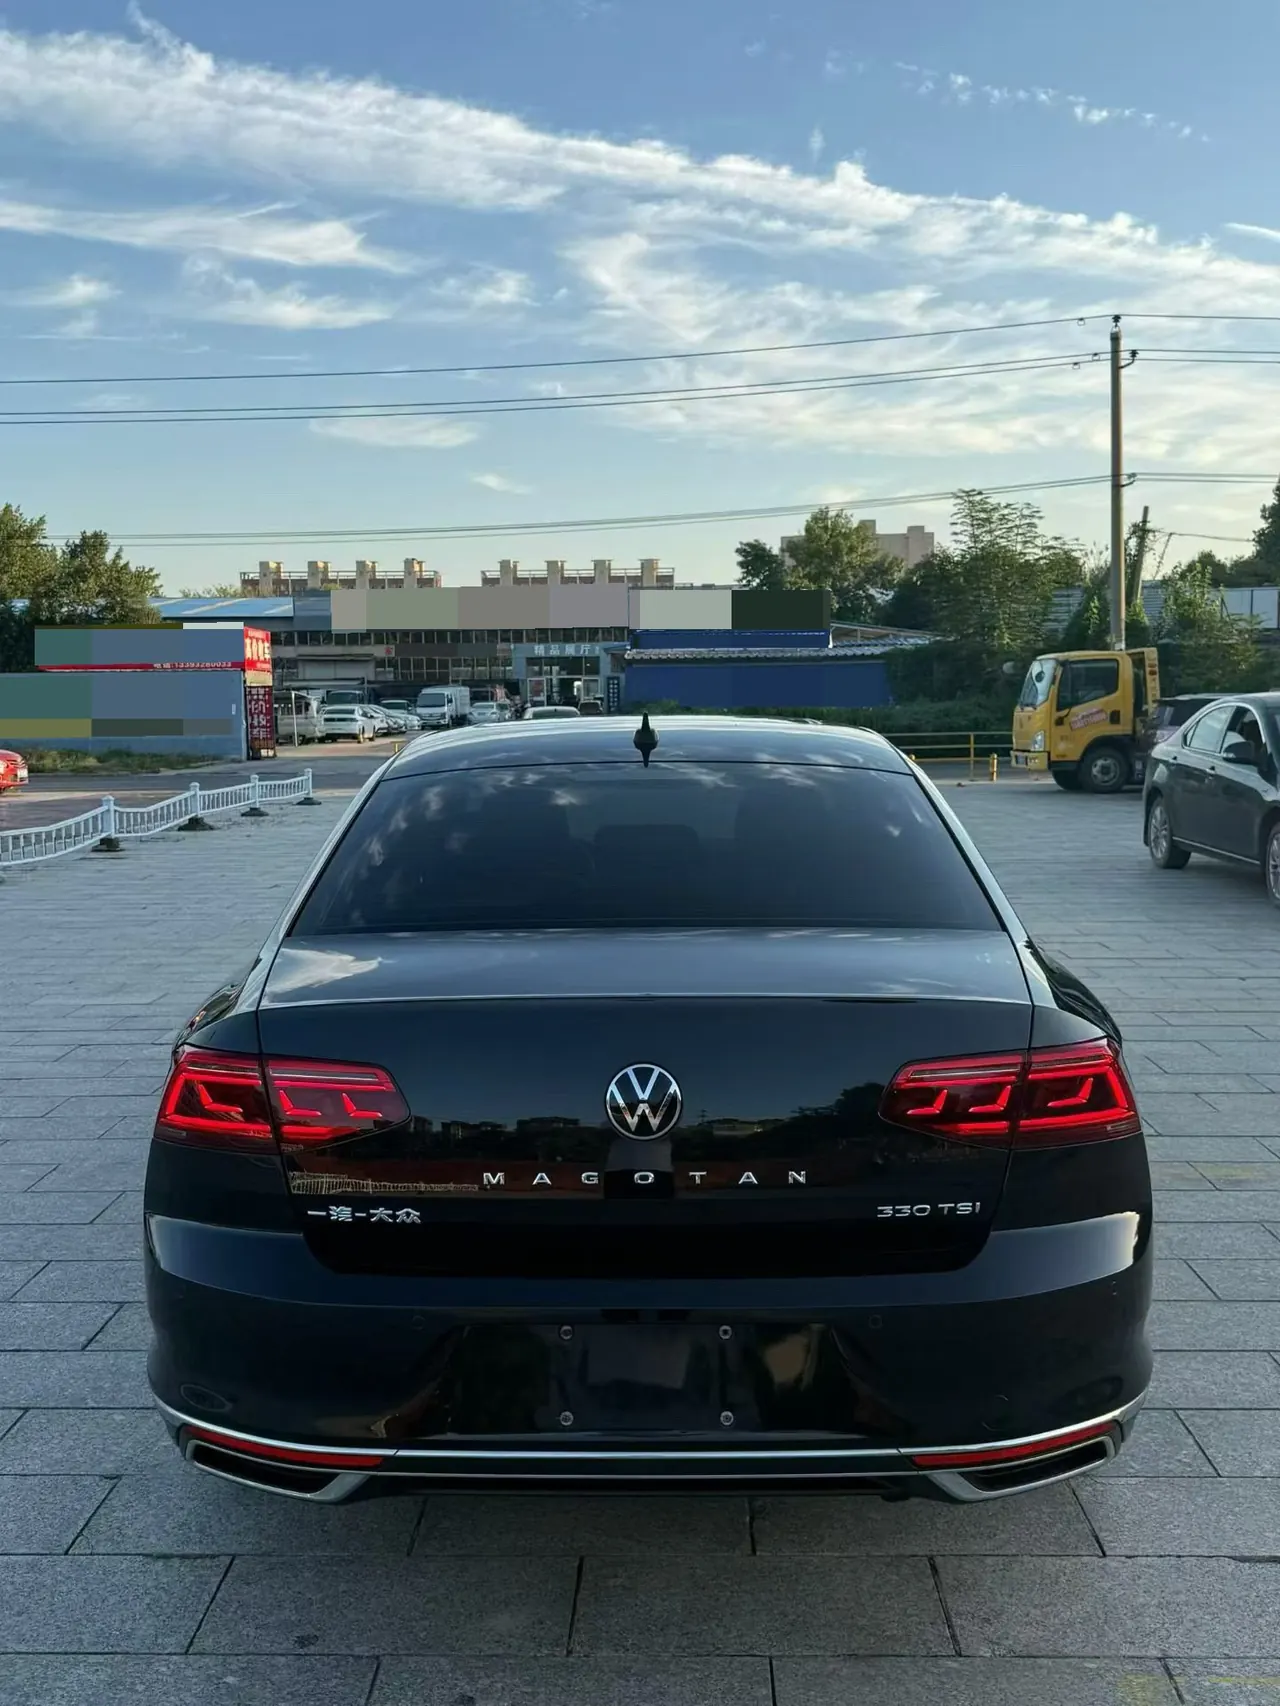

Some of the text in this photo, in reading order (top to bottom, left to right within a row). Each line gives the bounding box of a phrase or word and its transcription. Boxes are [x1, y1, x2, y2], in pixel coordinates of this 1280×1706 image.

[534, 644, 591, 656] 精品展厅
[482, 1170, 807, 1186] MAGOTAN
[306, 1205, 422, 1225] 一汽-大众
[876, 1201, 981, 1218] 330 TSI
